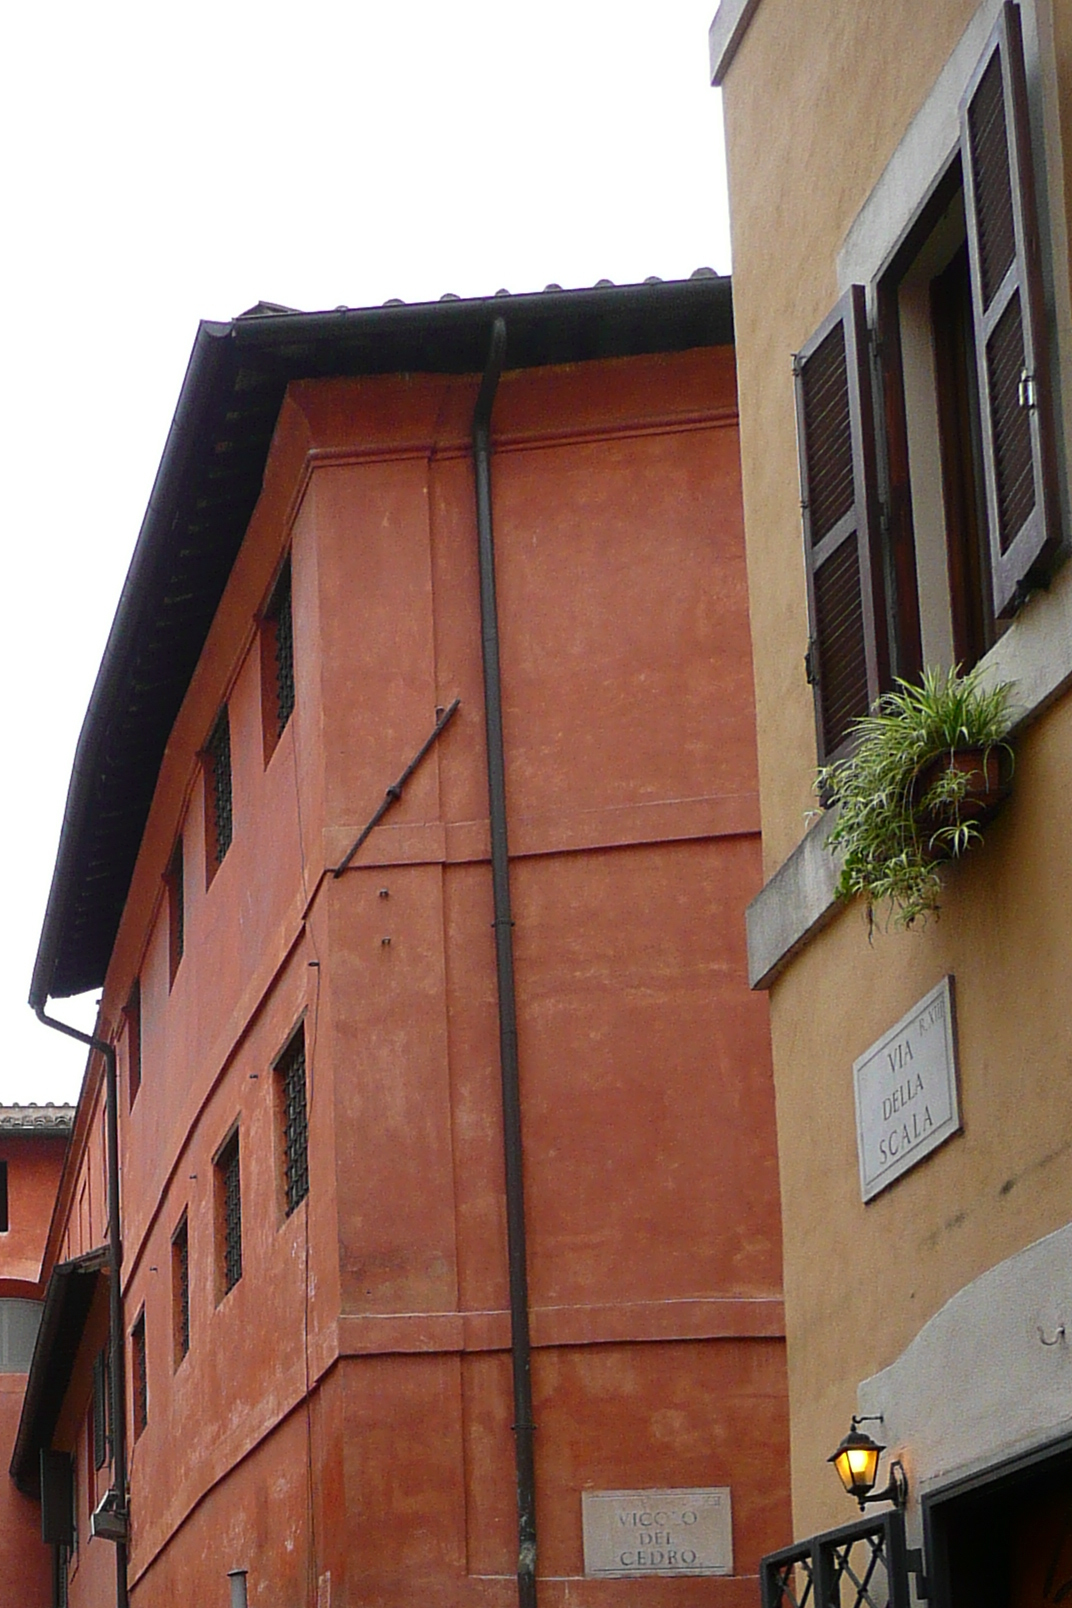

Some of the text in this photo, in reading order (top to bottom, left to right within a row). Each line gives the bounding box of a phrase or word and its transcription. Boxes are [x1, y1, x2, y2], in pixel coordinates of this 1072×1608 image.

[887, 1039, 914, 1073] VIA
[882, 1073, 924, 1121] DELLA
[879, 1104, 934, 1165] SCALA
[639, 1531, 675, 1546] DEL
[619, 1549, 697, 1566] CEDRO
